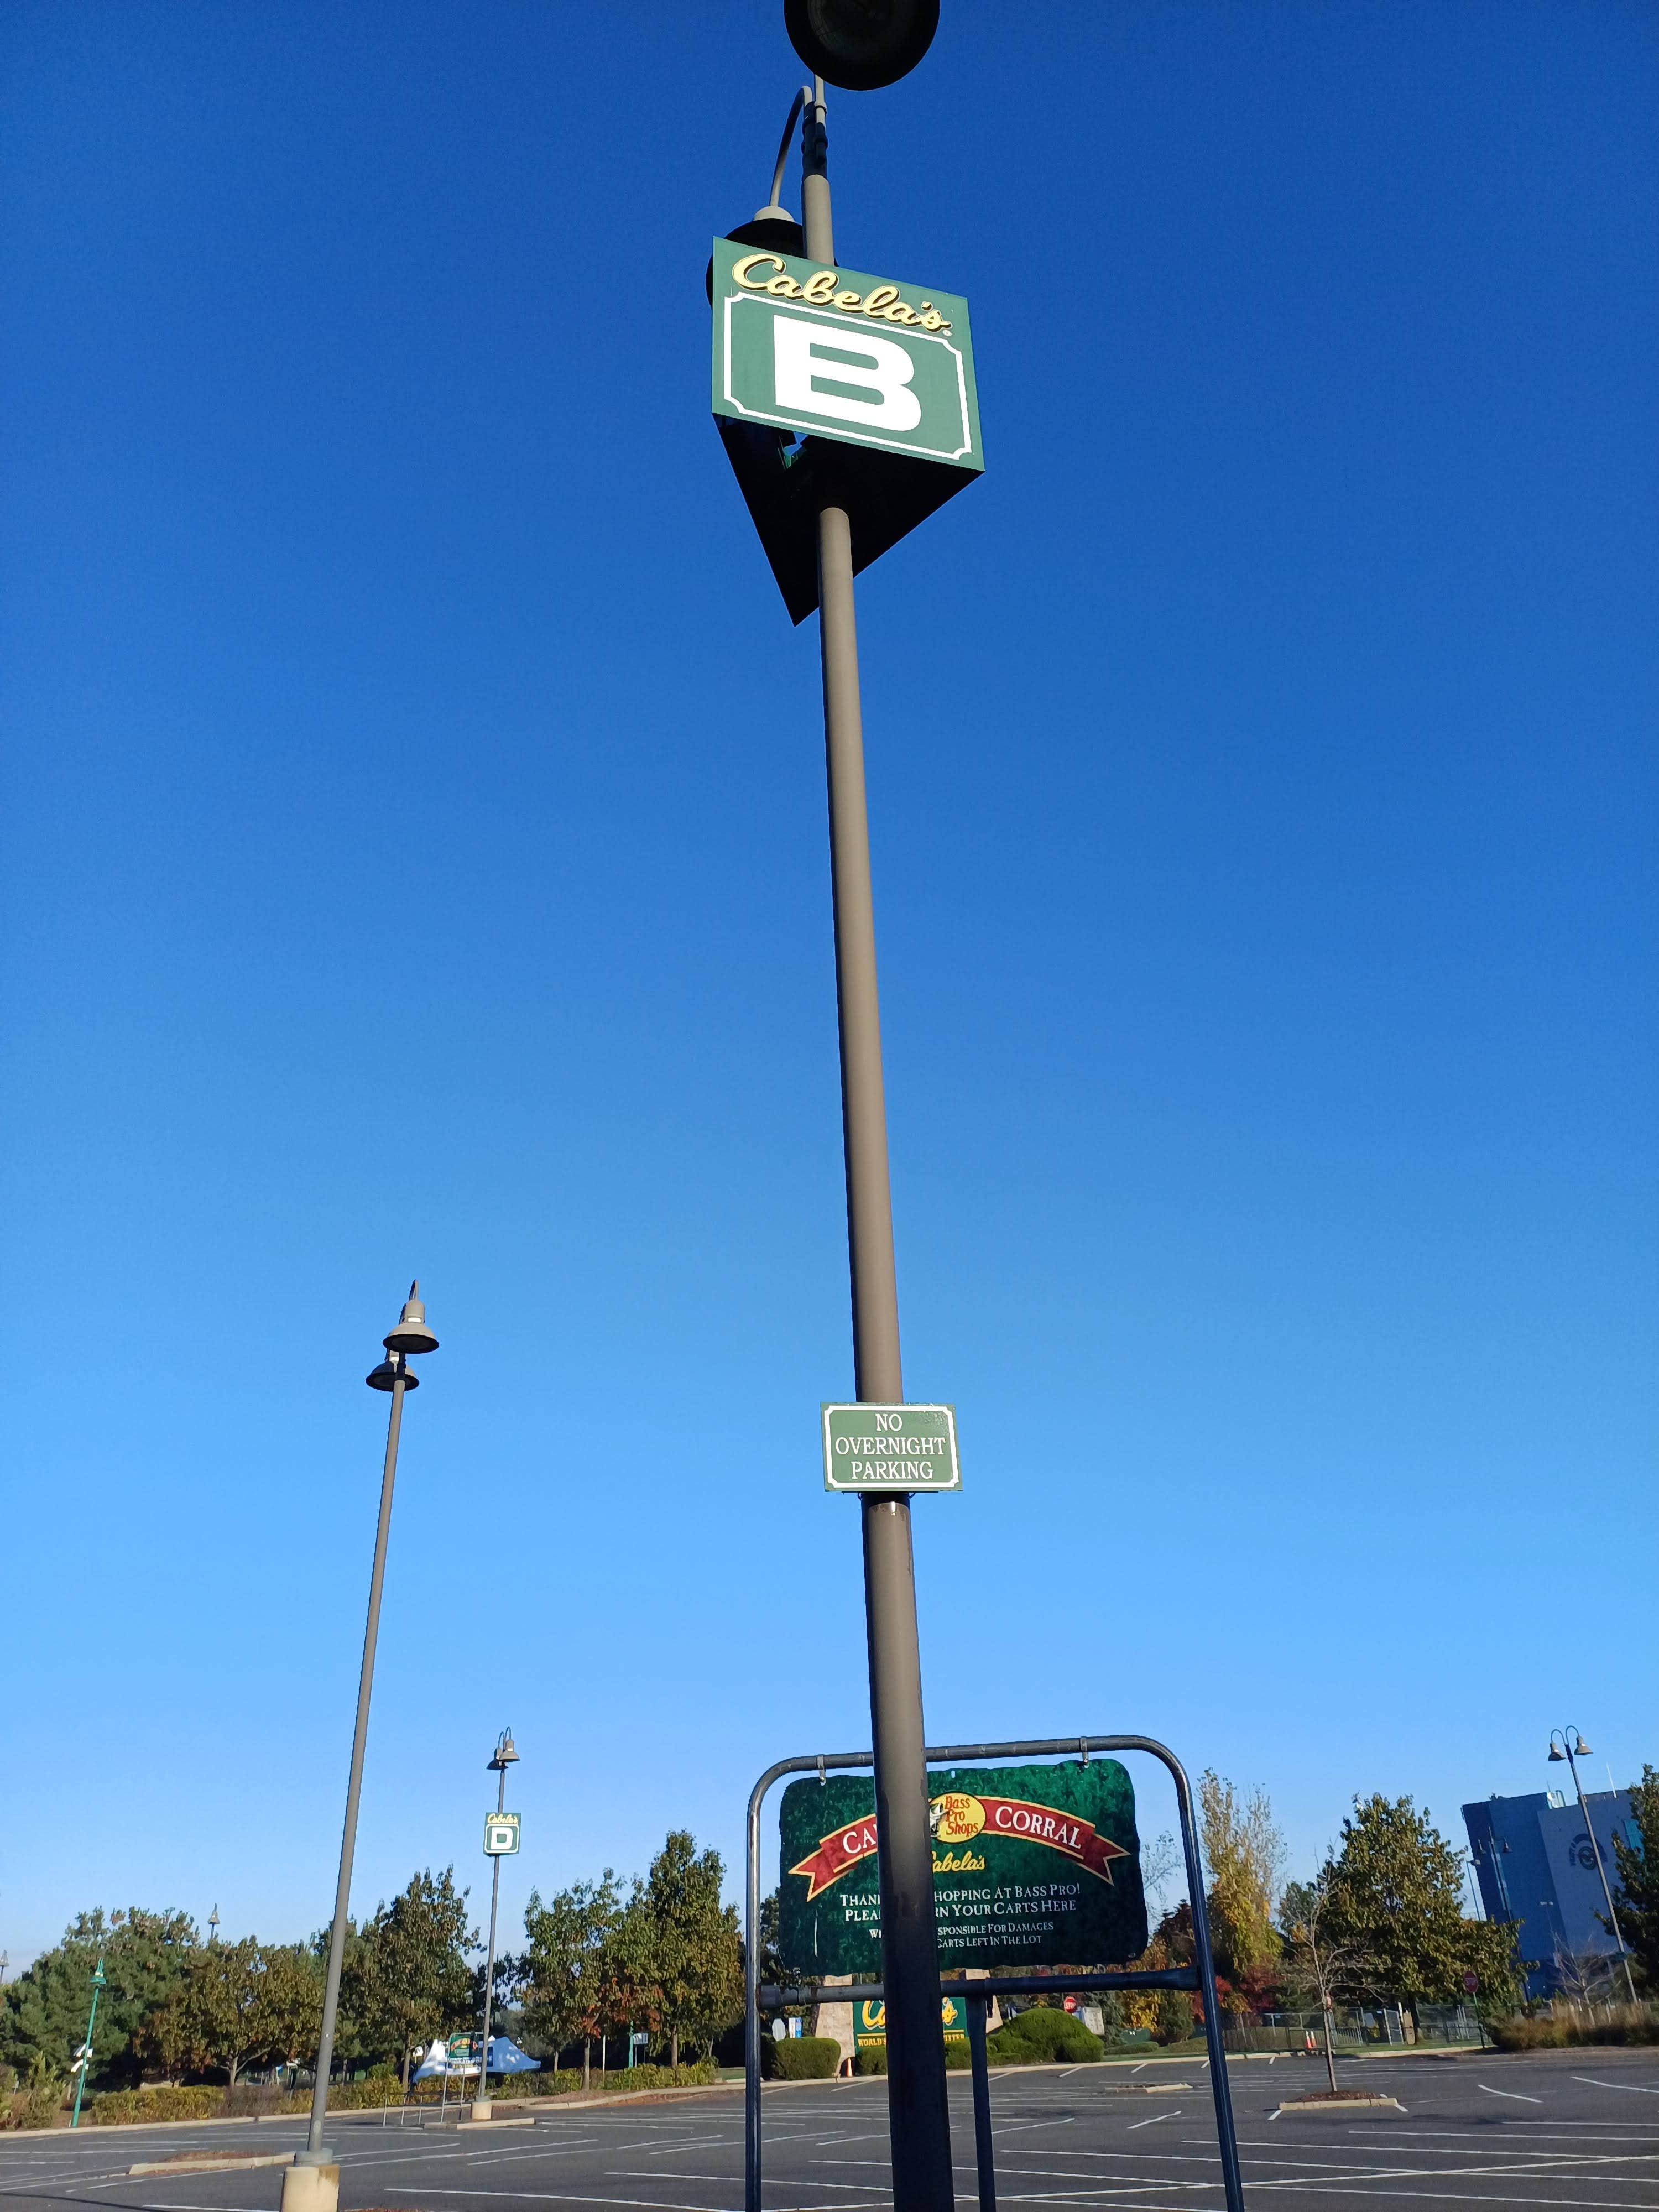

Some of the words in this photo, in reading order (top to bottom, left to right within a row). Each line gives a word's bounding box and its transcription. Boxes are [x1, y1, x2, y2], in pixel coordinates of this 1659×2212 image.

[732, 254, 952, 333] Cabela's
[774, 315, 921, 431] B
[875, 1414, 902, 1431] NO
[836, 1437, 946, 1455] OVERNIGHT
[851, 1461, 934, 1479] PARKING
[945, 1796, 971, 1809] Bass
[487, 1813, 518, 1824] Cabela's
[946, 1809, 966, 1822] Pro
[843, 1824, 878, 1854] CA
[995, 1806, 1081, 1849] CORRAL
[946, 1820, 979, 1838] Shops
[491, 1827, 513, 1850] D
[932, 1850, 985, 1872] abela's
[934, 1888, 991, 1902] HOPPING
[994, 1886, 1011, 1899] AT
[1015, 1885, 1047, 1898] BASS
[1050, 1883, 1081, 1896] PRO!
[845, 1909, 881, 1921] PLEA
[952, 1904, 992, 1917] YOUR
[994, 1902, 1039, 1914] CARTS
[1041, 1900, 1077, 1912] HERE
[937, 1924, 987, 1936] SPONSIBLE
[988, 1923, 1006, 1933] FOR
[1008, 1922, 1054, 1932] DAMAGES
[966, 1937, 989, 1947] LEFT
[990, 1936, 1000, 1947] IN
[1001, 1936, 1021, 1945] THE
[1022, 1934, 1042, 1944] LOT
